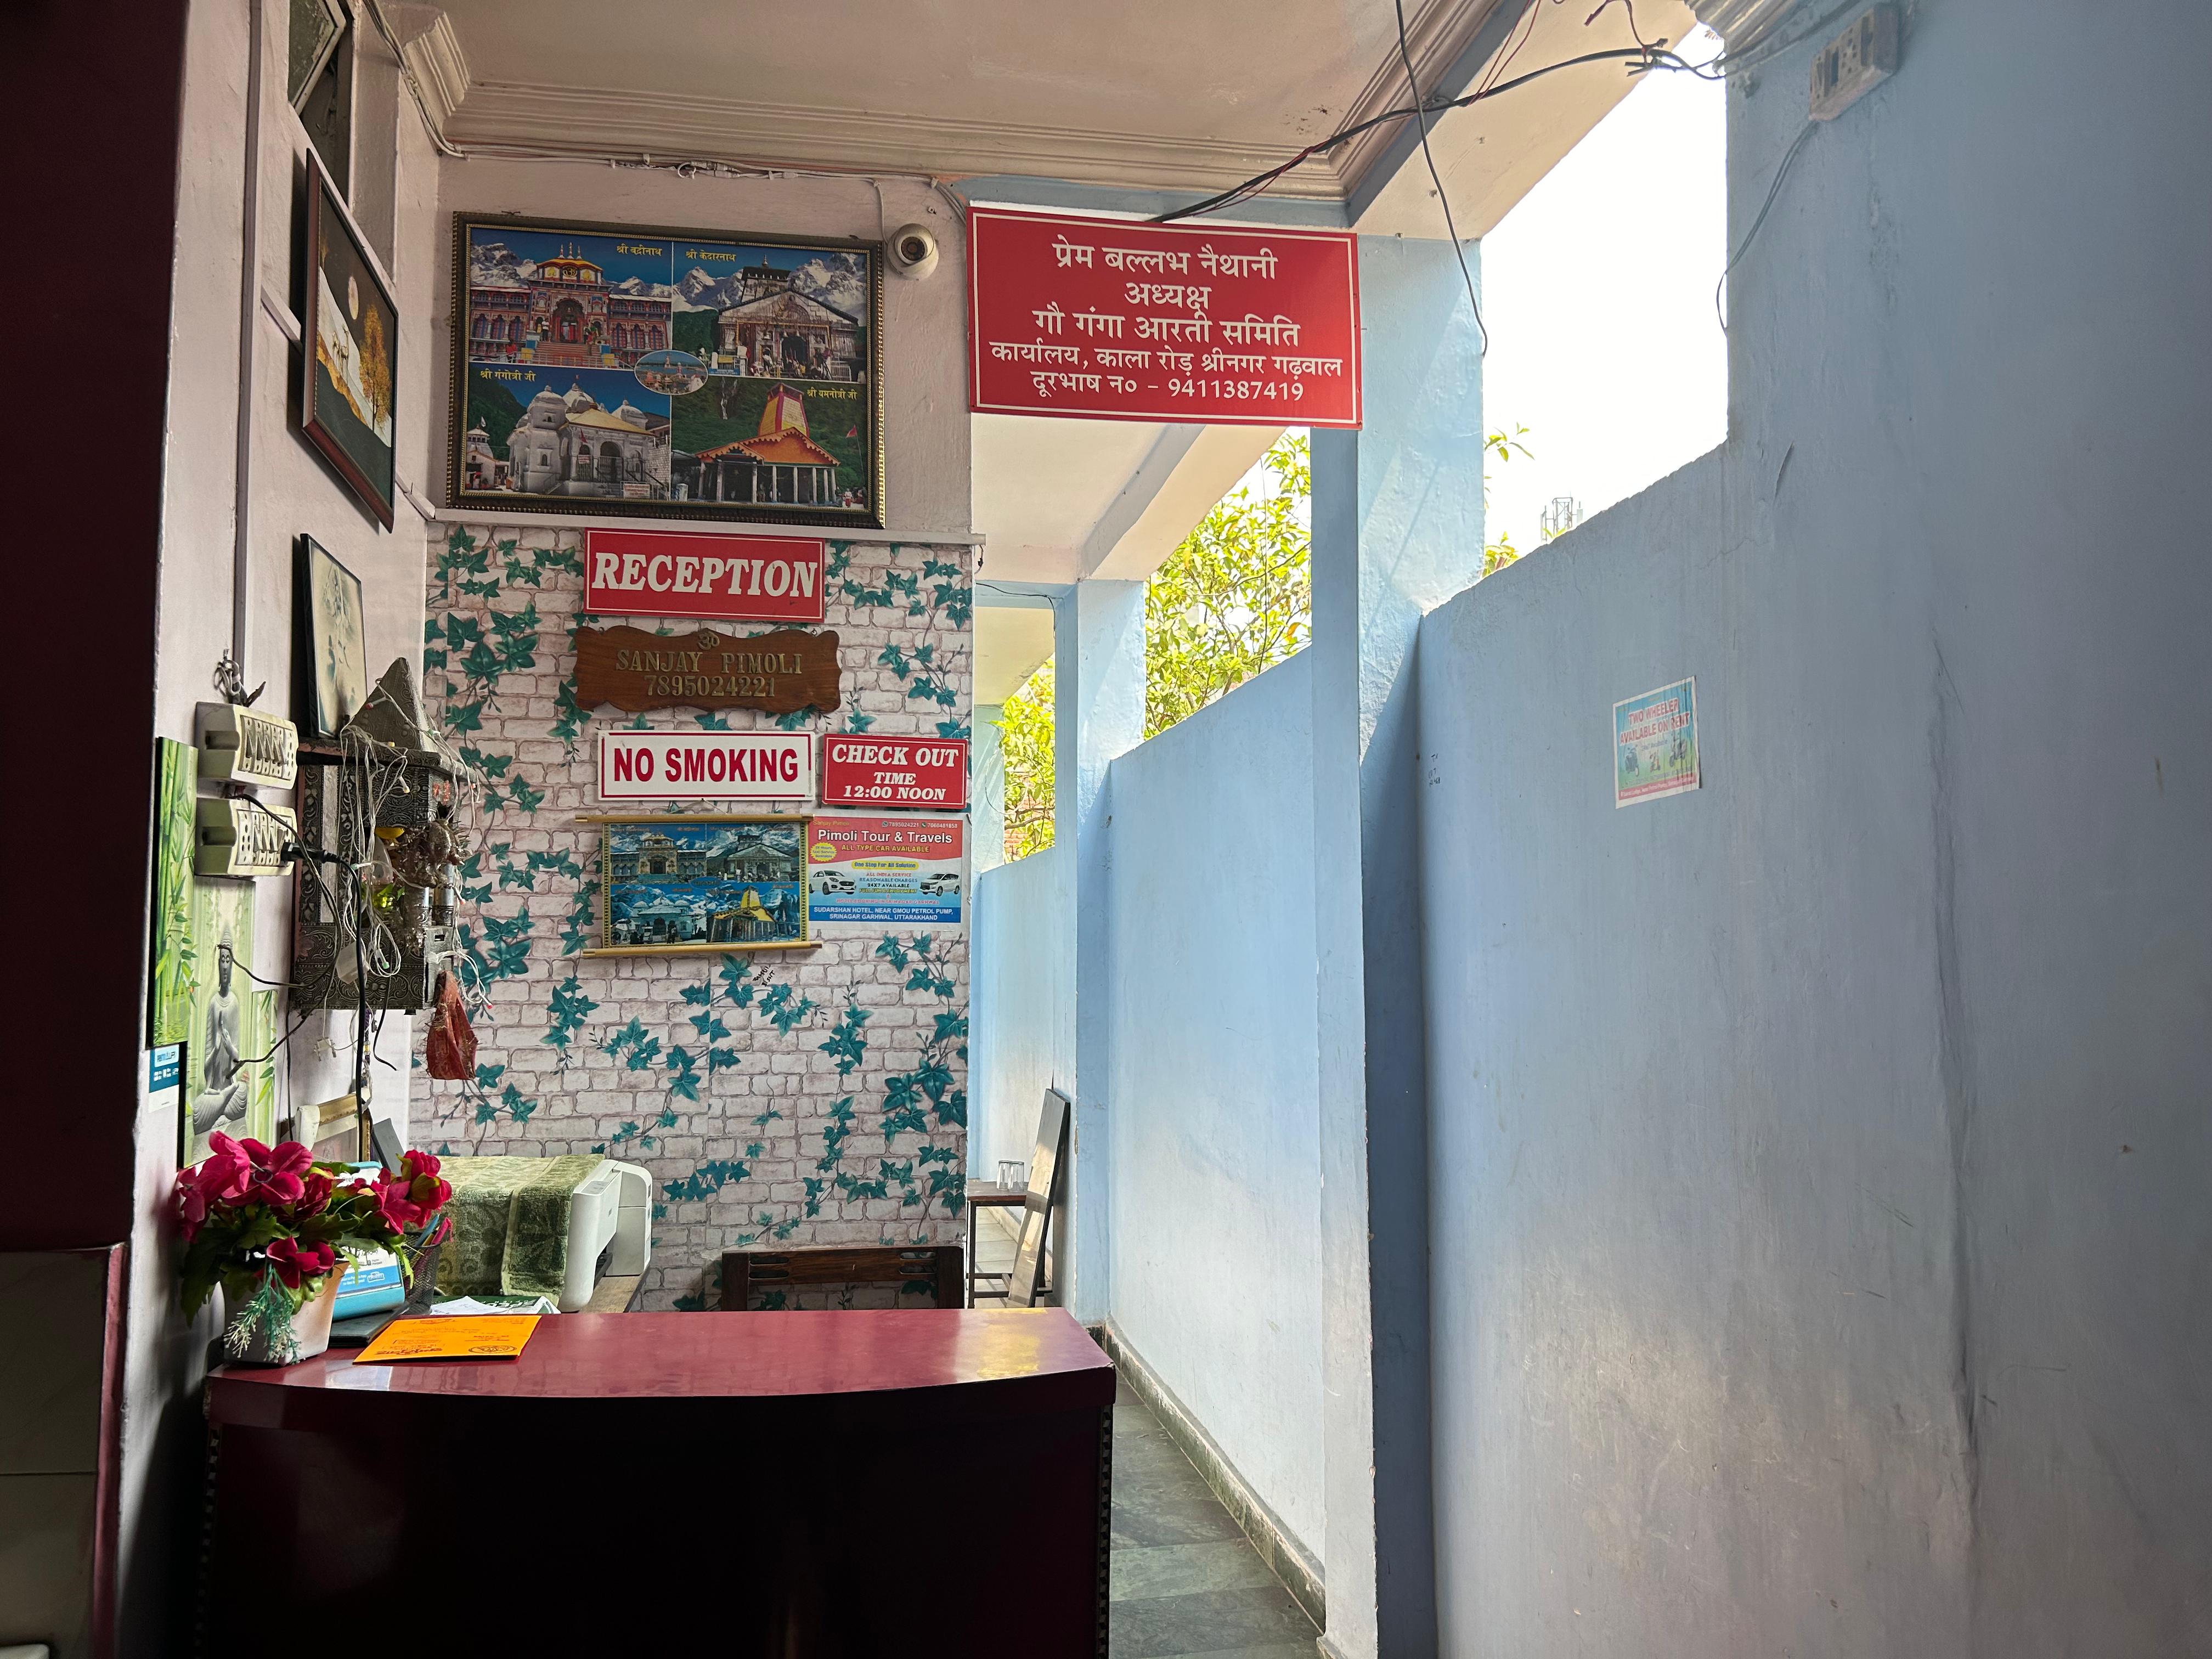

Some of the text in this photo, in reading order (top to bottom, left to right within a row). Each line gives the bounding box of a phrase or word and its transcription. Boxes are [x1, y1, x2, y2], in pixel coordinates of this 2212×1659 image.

[617, 243, 628, 255] श्री
[686, 249, 697, 259] श्री
[1052, 234, 1278, 279] प्रेम बल्लभ नैथानी
[1125, 283, 1212, 310] अध्यक्ष
[1032, 301, 1301, 347] गौ गंगा आरती समिति
[989, 337, 1343, 381] कार्यालय, काला रोड़ श्रीनगर गढ़वाल
[481, 368, 493, 379] श्री
[524, 370, 536, 382] जी
[1030, 371, 1102, 397] दूरभाष
[1168, 378, 1304, 401] 9411387419
[848, 389, 857, 400] जी
[591, 552, 817, 597] RECEPTION
[616, 650, 802, 674] SANJAY PIMOLI
[644, 675, 775, 697] 7895024221
[1628, 699, 1678, 725] TWO WHEELER
[1620, 712, 1690, 744] AVAILABLE ON RENT
[614, 748, 798, 782] NO SMOKING
[832, 744, 958, 767] CHECK OUT
[873, 772, 916, 785] TIME
[843, 786, 946, 800] 12:00 NOON
[818, 829, 952, 843] Pimoli Tour & Travels
